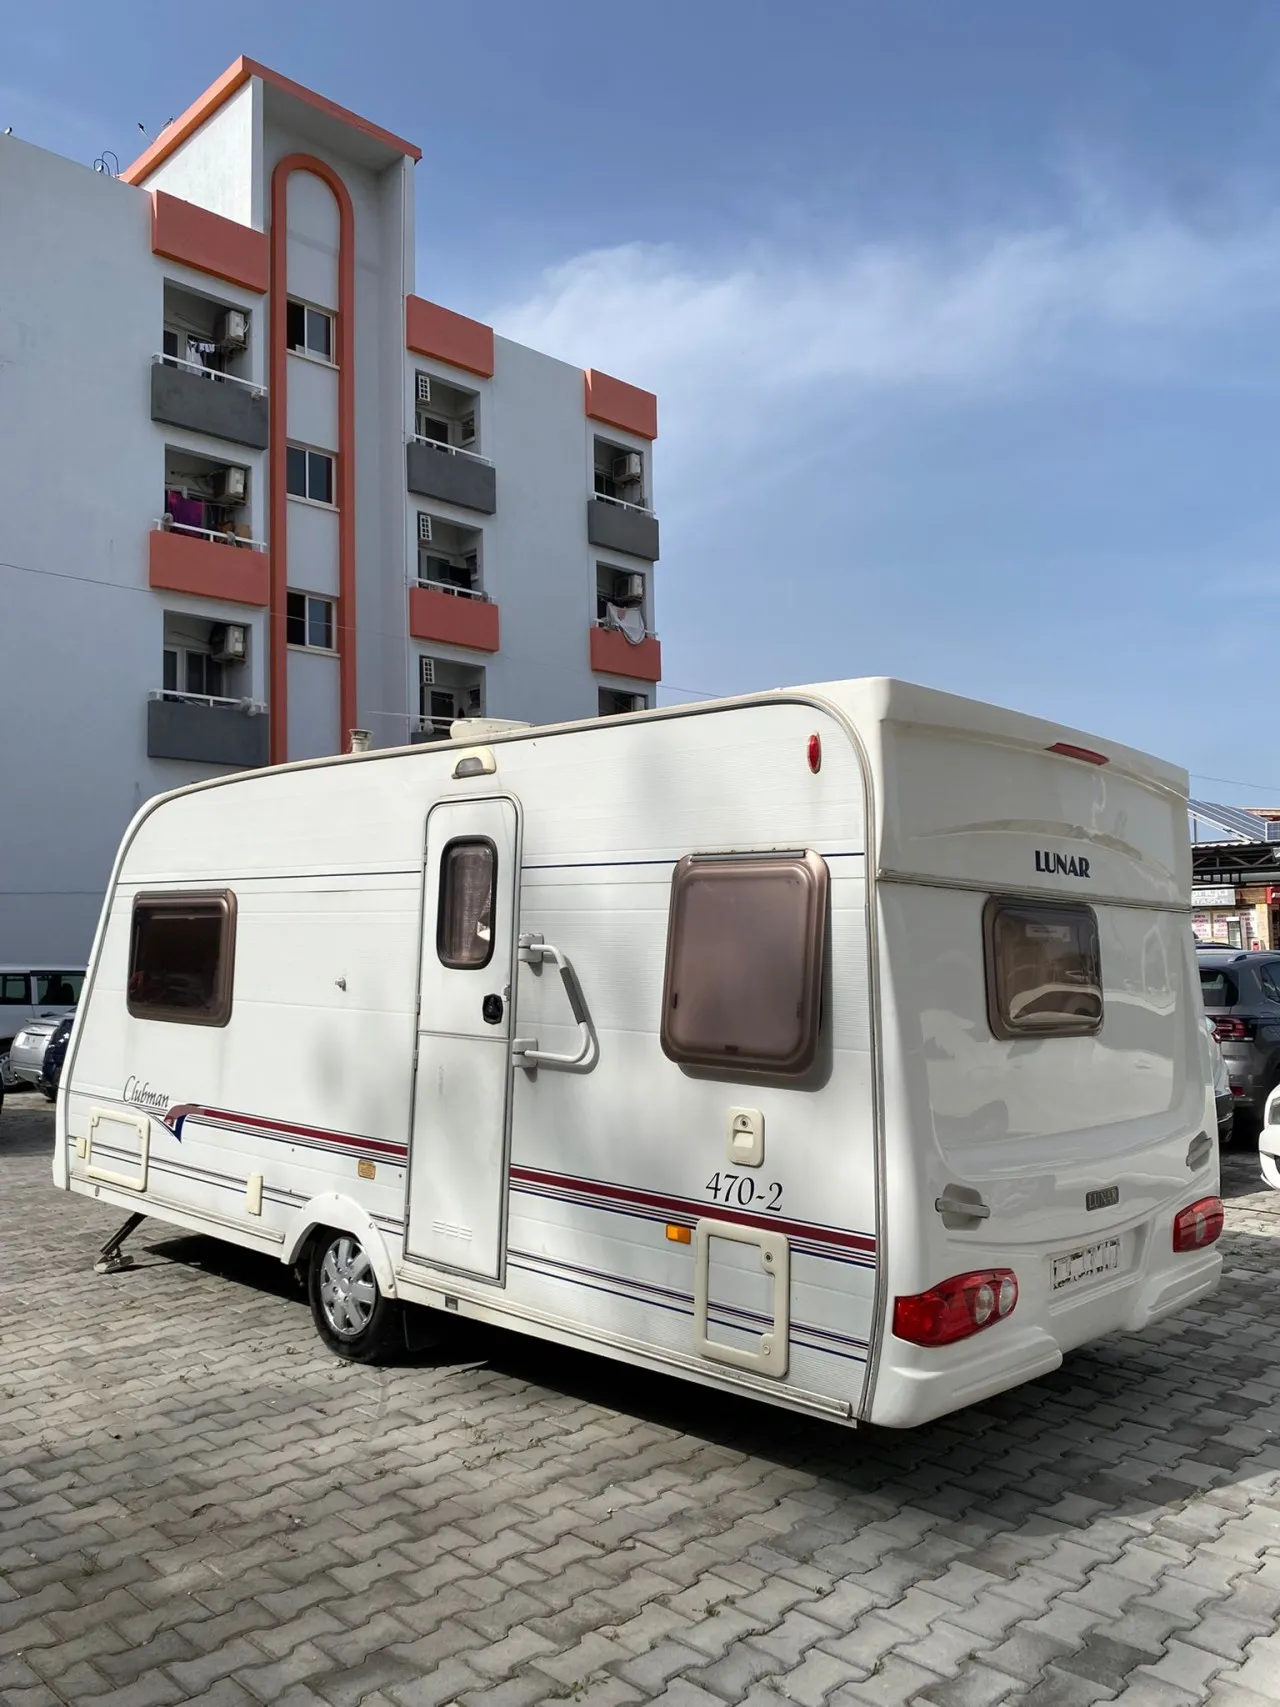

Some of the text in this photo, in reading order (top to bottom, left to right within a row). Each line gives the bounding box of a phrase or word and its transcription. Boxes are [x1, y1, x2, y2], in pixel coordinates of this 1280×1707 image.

[1034, 849, 1091, 879] LUNAR
[123, 1075, 169, 1108] Clubman
[705, 1172, 783, 1212] 470-2
[1088, 1189, 1118, 1208] LUNAR
